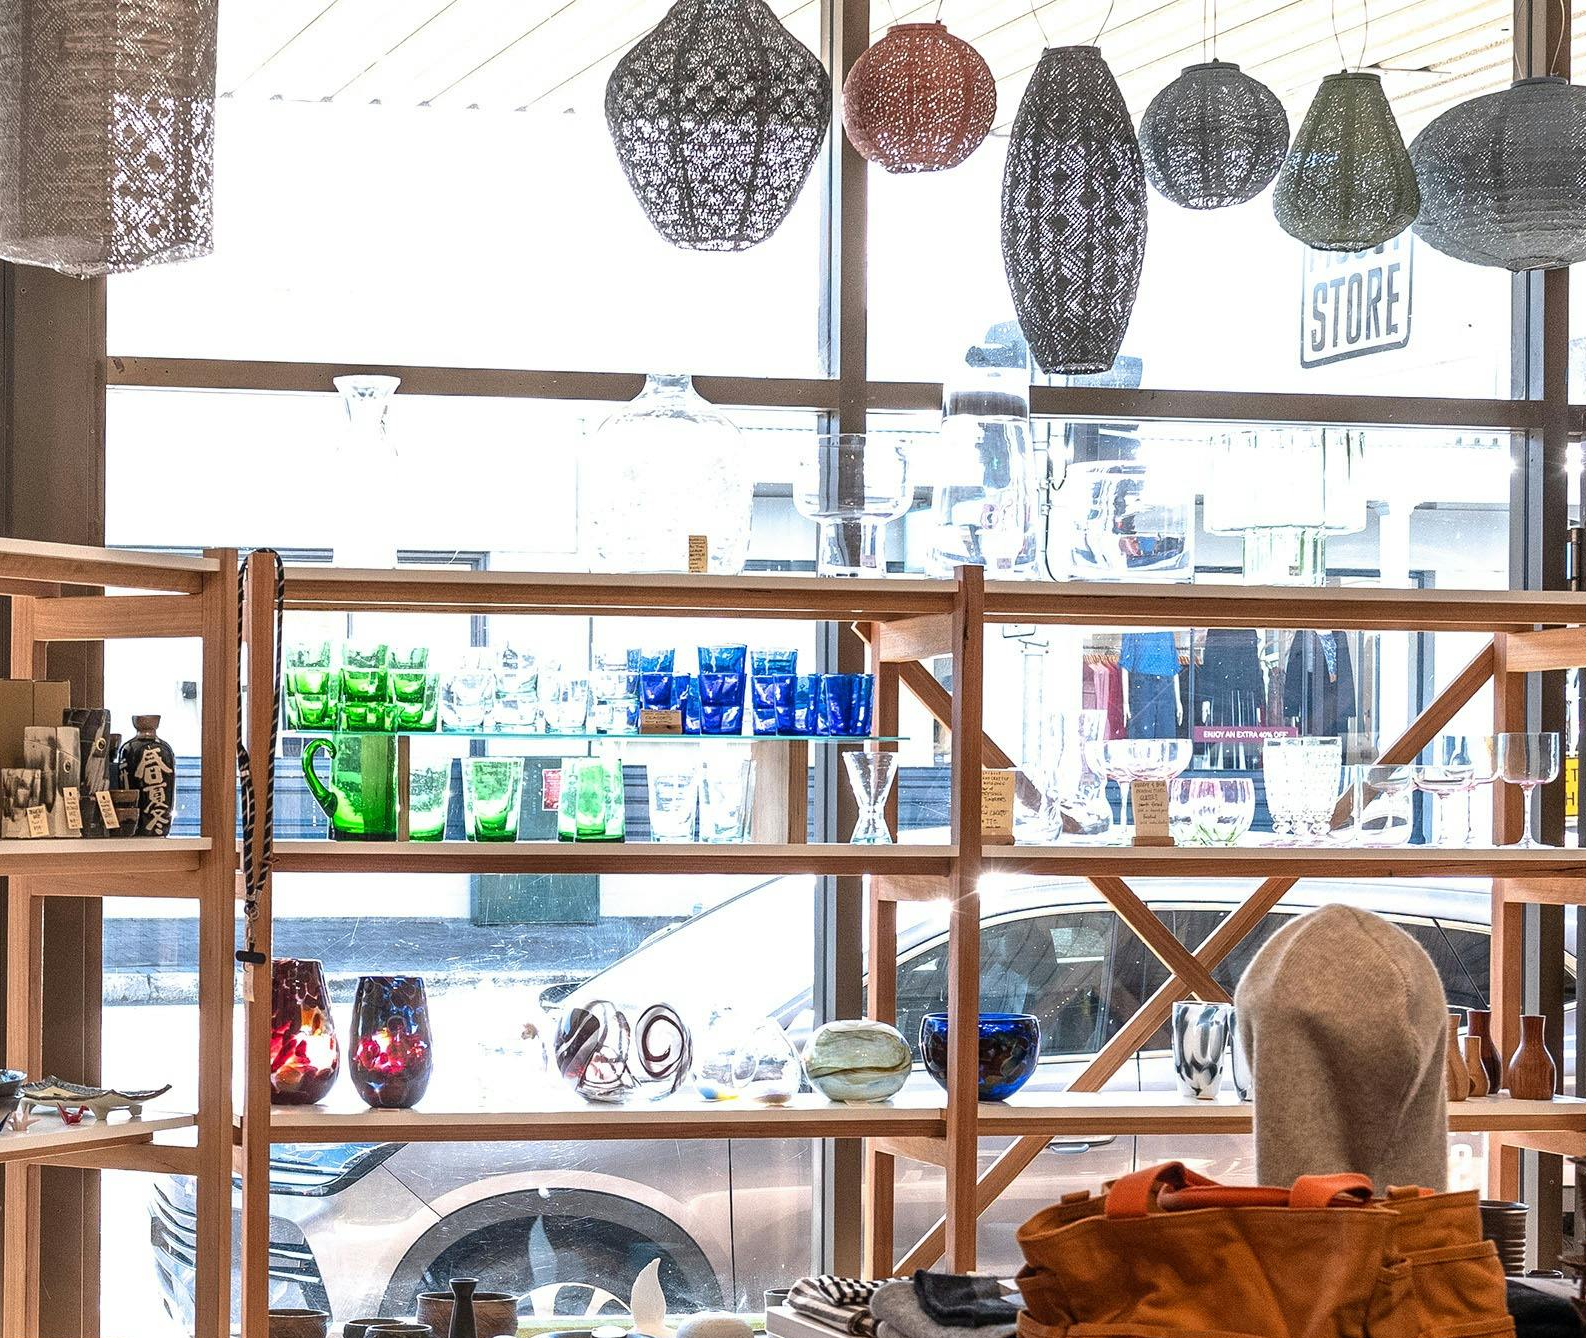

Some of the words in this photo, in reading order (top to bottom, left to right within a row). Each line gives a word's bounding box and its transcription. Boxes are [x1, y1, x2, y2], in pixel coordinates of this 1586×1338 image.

[1311, 262, 1401, 352] STORE
[1203, 730, 1225, 738] ENJOY
[1225, 730, 1235, 738] AN
[1236, 730, 1258, 738] EXTRA
[1259, 730, 1272, 738] 40%
